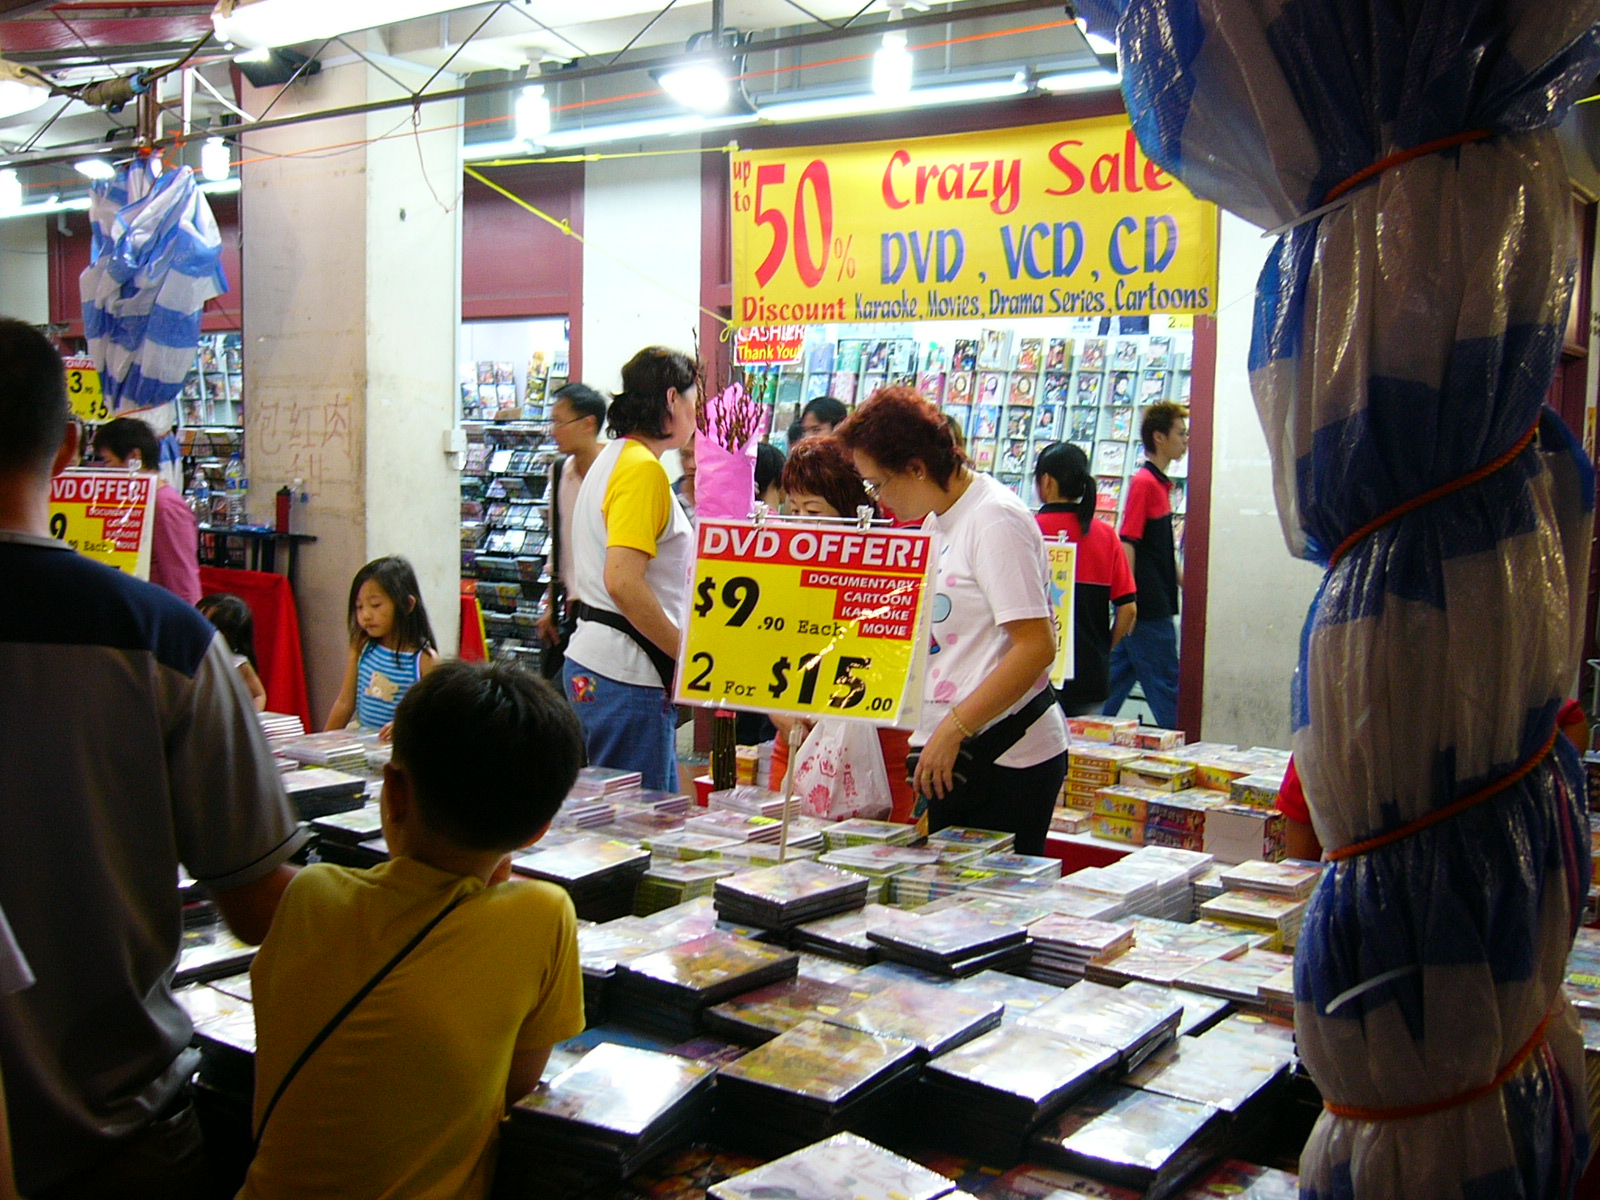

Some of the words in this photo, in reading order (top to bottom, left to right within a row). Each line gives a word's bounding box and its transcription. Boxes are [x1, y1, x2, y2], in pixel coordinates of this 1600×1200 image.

[733, 160, 751, 184] up
[882, 149, 1022, 215] Crazy
[1045, 128, 1174, 197] Sale
[734, 192, 751, 213] to
[1108, 214, 1179, 275] CD
[742, 296, 847, 322] Discount
[855, 292, 924, 320] Karaoke,
[927, 288, 986, 318] Movies,
[989, 287, 1044, 315] Drama
[1048, 284, 1113, 314] Series,
[1115, 278, 1209, 312] Cartoons
[738, 344, 774, 360] Thank
[52, 479, 77, 499] VD
[80, 479, 148, 502] OFFER!
[702, 526, 781, 558] DVD
[788, 531, 924, 568] OFFER!
[808, 573, 916, 590] DOCUMENTARY
[694, 576, 785, 631] $9.90
[797, 620, 843, 637] Each
[843, 590, 912, 606] CARTOON
[841, 606, 910, 621] KARAOKE
[861, 622, 907, 636] MOVIE
[686, 652, 715, 692] 2
[723, 680, 757, 697] For
[767, 652, 893, 712] $15.00
